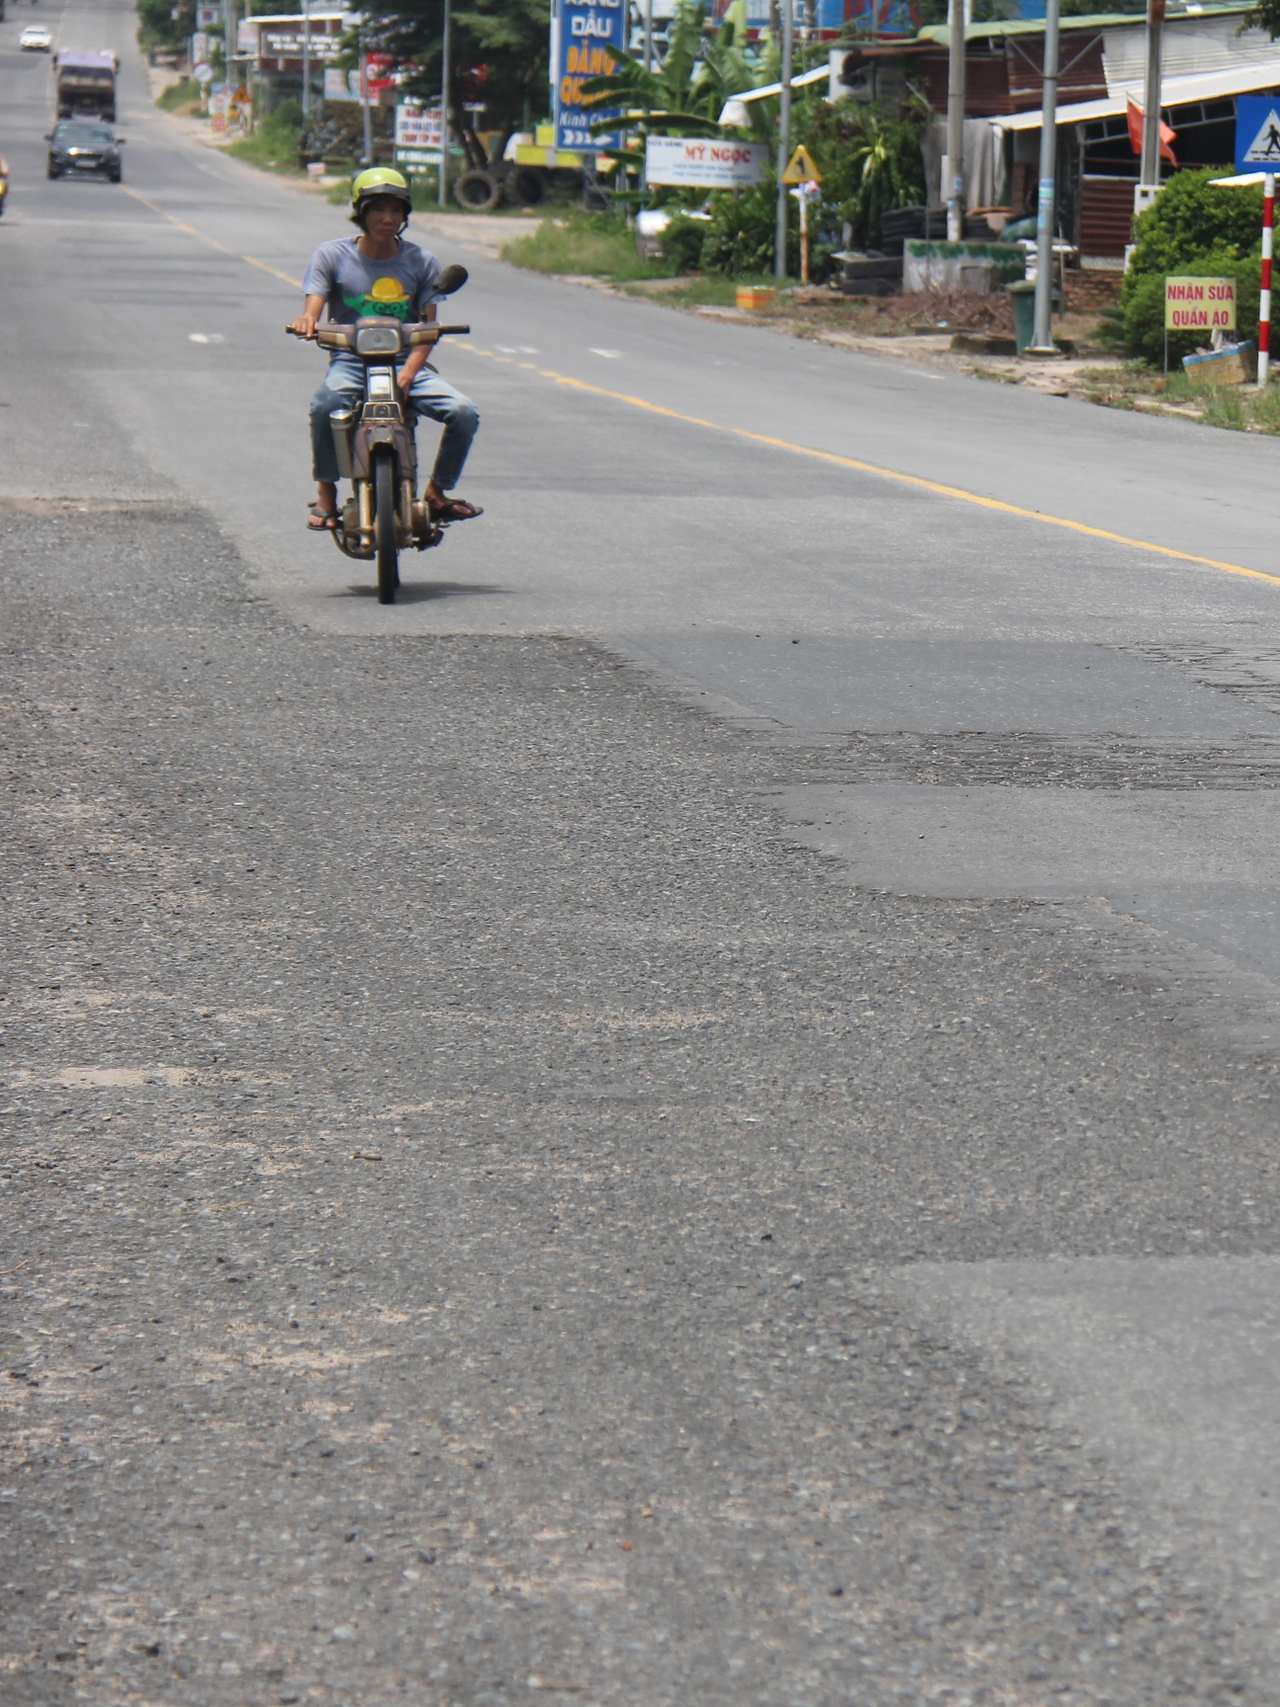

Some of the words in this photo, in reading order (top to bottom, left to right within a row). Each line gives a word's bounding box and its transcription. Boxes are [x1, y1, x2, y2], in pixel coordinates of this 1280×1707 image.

[710, 146, 751, 166] NGỌC
[1167, 282, 1204, 304] NHẬN
[1208, 280, 1234, 300] SỬA
[1212, 307, 1229, 326] ÁO
